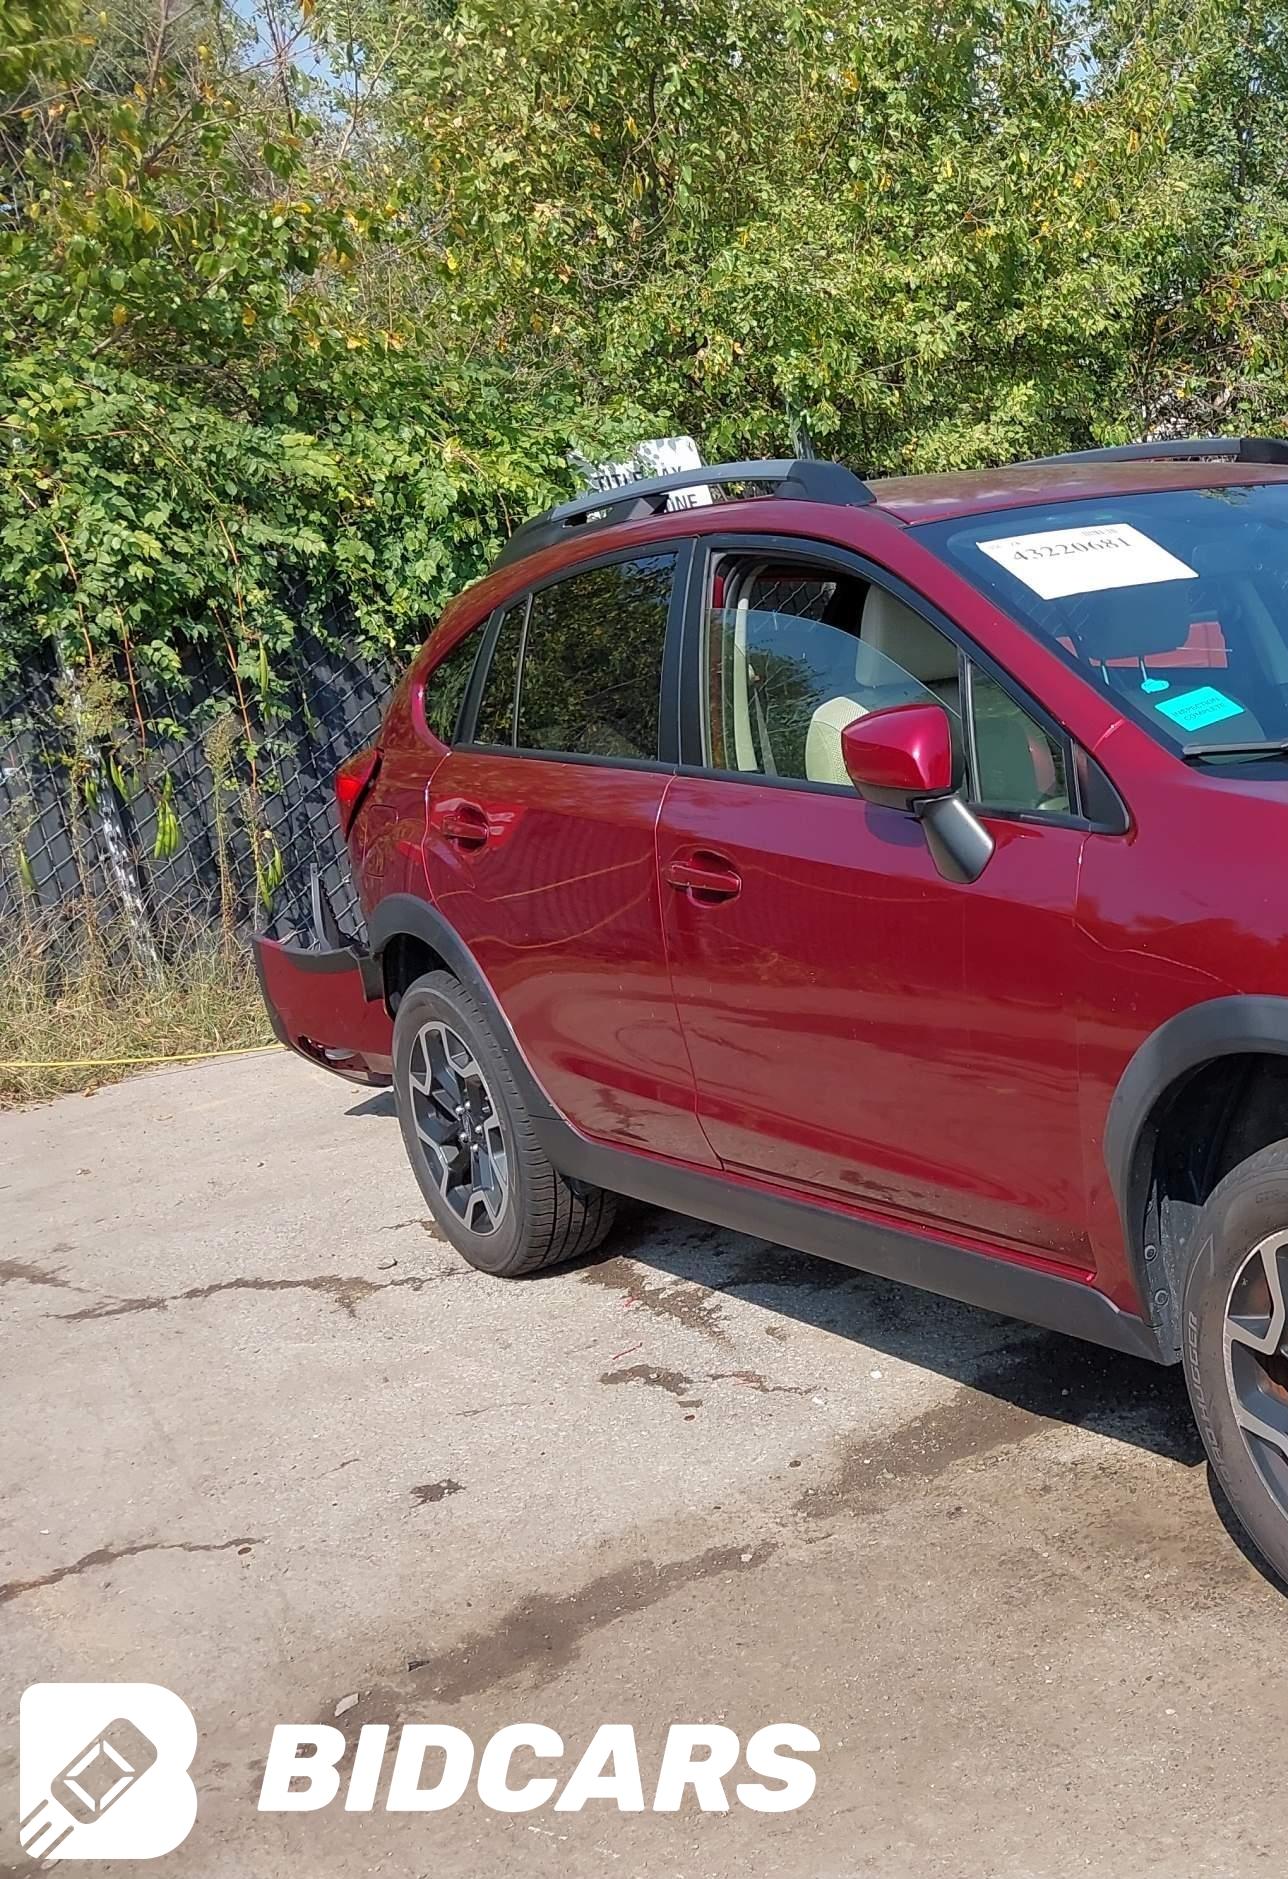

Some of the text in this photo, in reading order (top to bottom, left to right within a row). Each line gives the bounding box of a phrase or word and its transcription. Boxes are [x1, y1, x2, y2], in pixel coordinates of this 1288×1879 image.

[666, 494, 698, 512] ONE
[1014, 537, 1131, 560] 43220681
[1184, 703, 1224, 720] COMPLETE
[1188, 1311, 1212, 1424] HUGGER
